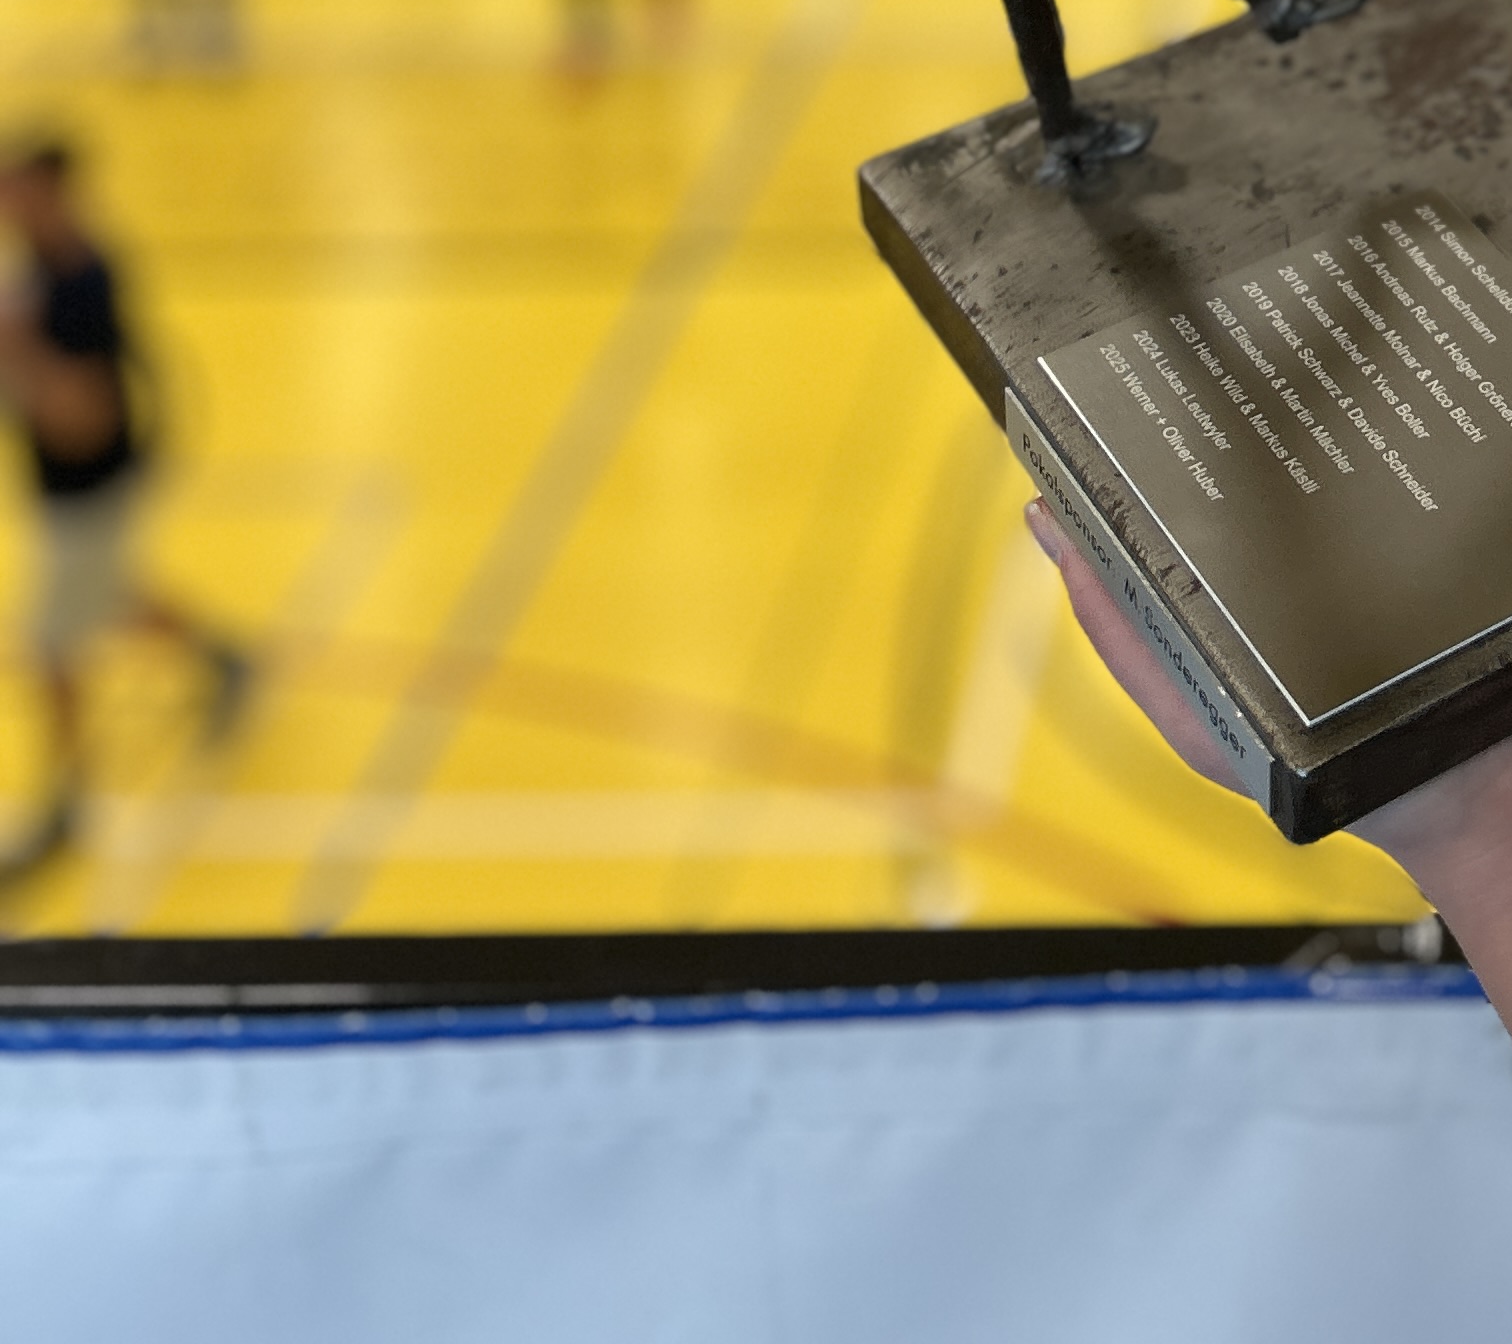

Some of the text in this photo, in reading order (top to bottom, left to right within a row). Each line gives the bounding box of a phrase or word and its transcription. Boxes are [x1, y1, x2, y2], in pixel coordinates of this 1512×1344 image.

[1346, 235, 1379, 263] 2016
[1370, 262, 1415, 307] Andreas
[1409, 305, 1439, 334] Rutz
[1434, 332, 1450, 345] &
[1443, 341, 1482, 381] Holger
[1381, 220, 1497, 344] 2015 Markus Bachmann
[1414, 205, 1447, 232] 2014
[1440, 231, 1475, 267] Simon
[1132, 329, 1164, 361] 2024
[1155, 358, 1188, 396] Lukas
[1169, 313, 1201, 344] 2023
[1219, 374, 1249, 404] Wild
[1240, 402, 1256, 416] &
[1248, 413, 1289, 459] Markus
[1205, 297, 1238, 327] 2020
[1228, 325, 1277, 378] Elisabeth
[1271, 377, 1287, 390] &
[1279, 387, 1315, 428] Martin
[1241, 281, 1439, 511] 2019 Patrick Schwarz & Davide Schneider
[1277, 265, 1431, 439] 2018 Jonas Michel & Yves Boller
[1312, 250, 1345, 277] 2017
[1336, 279, 1386, 331] Jeannette
[1382, 329, 1422, 369] Molnar
[1416, 369, 1432, 382] &
[1424, 379, 1454, 408] Nico
[1099, 343, 1131, 374] 2025
[1122, 371, 1161, 416] Werner
[1162, 426, 1195, 462] Oliver
[1187, 461, 1225, 501] Huber
